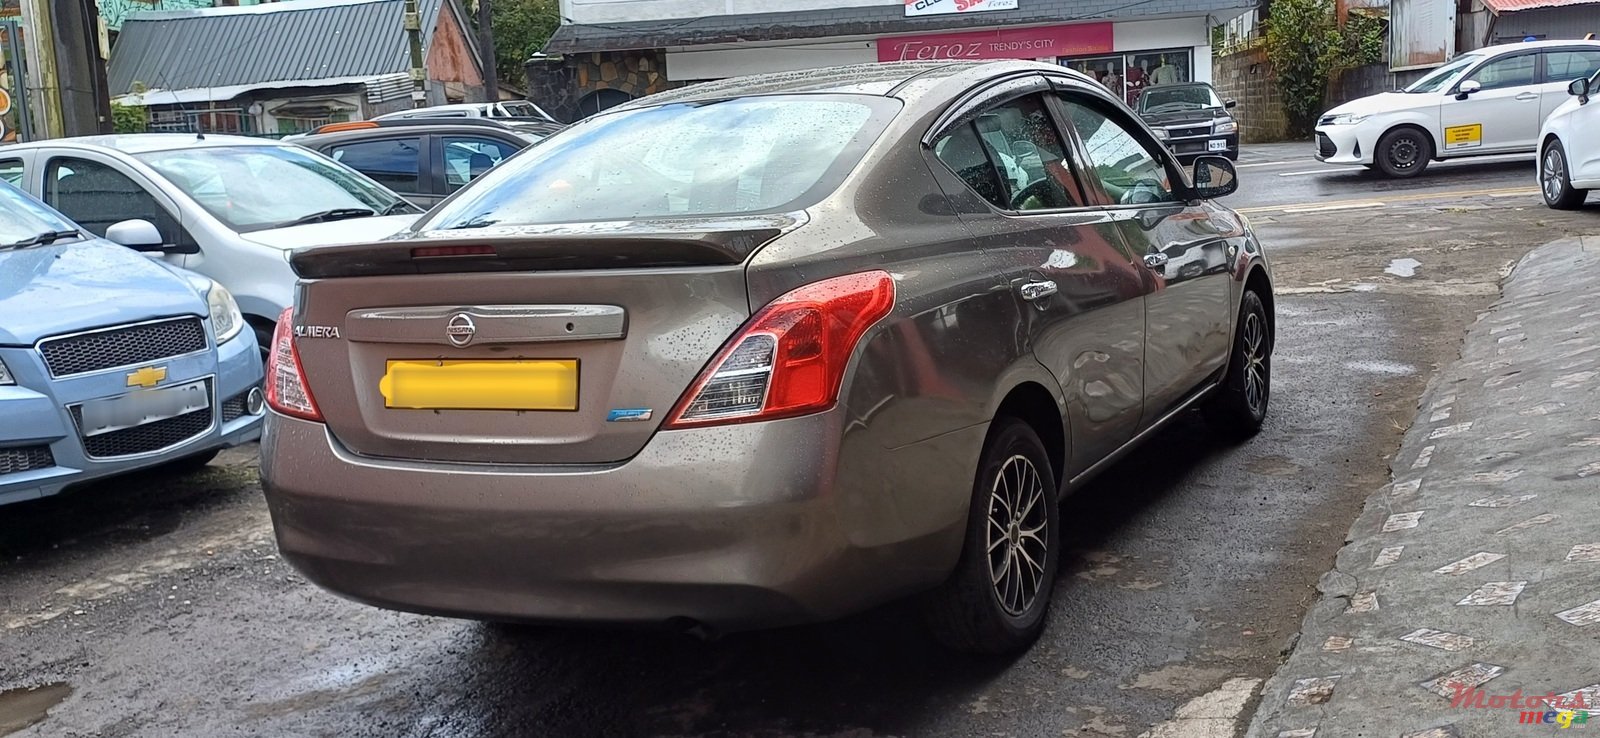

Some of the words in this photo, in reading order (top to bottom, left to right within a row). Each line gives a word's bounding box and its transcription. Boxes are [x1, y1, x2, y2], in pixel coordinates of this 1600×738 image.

[894, 41, 982, 61] Feroz
[989, 40, 1032, 52] TRENDY'S
[1034, 38, 1055, 49] CITY
[294, 325, 340, 338] ALMERA
[448, 326, 475, 335] NISSAN
